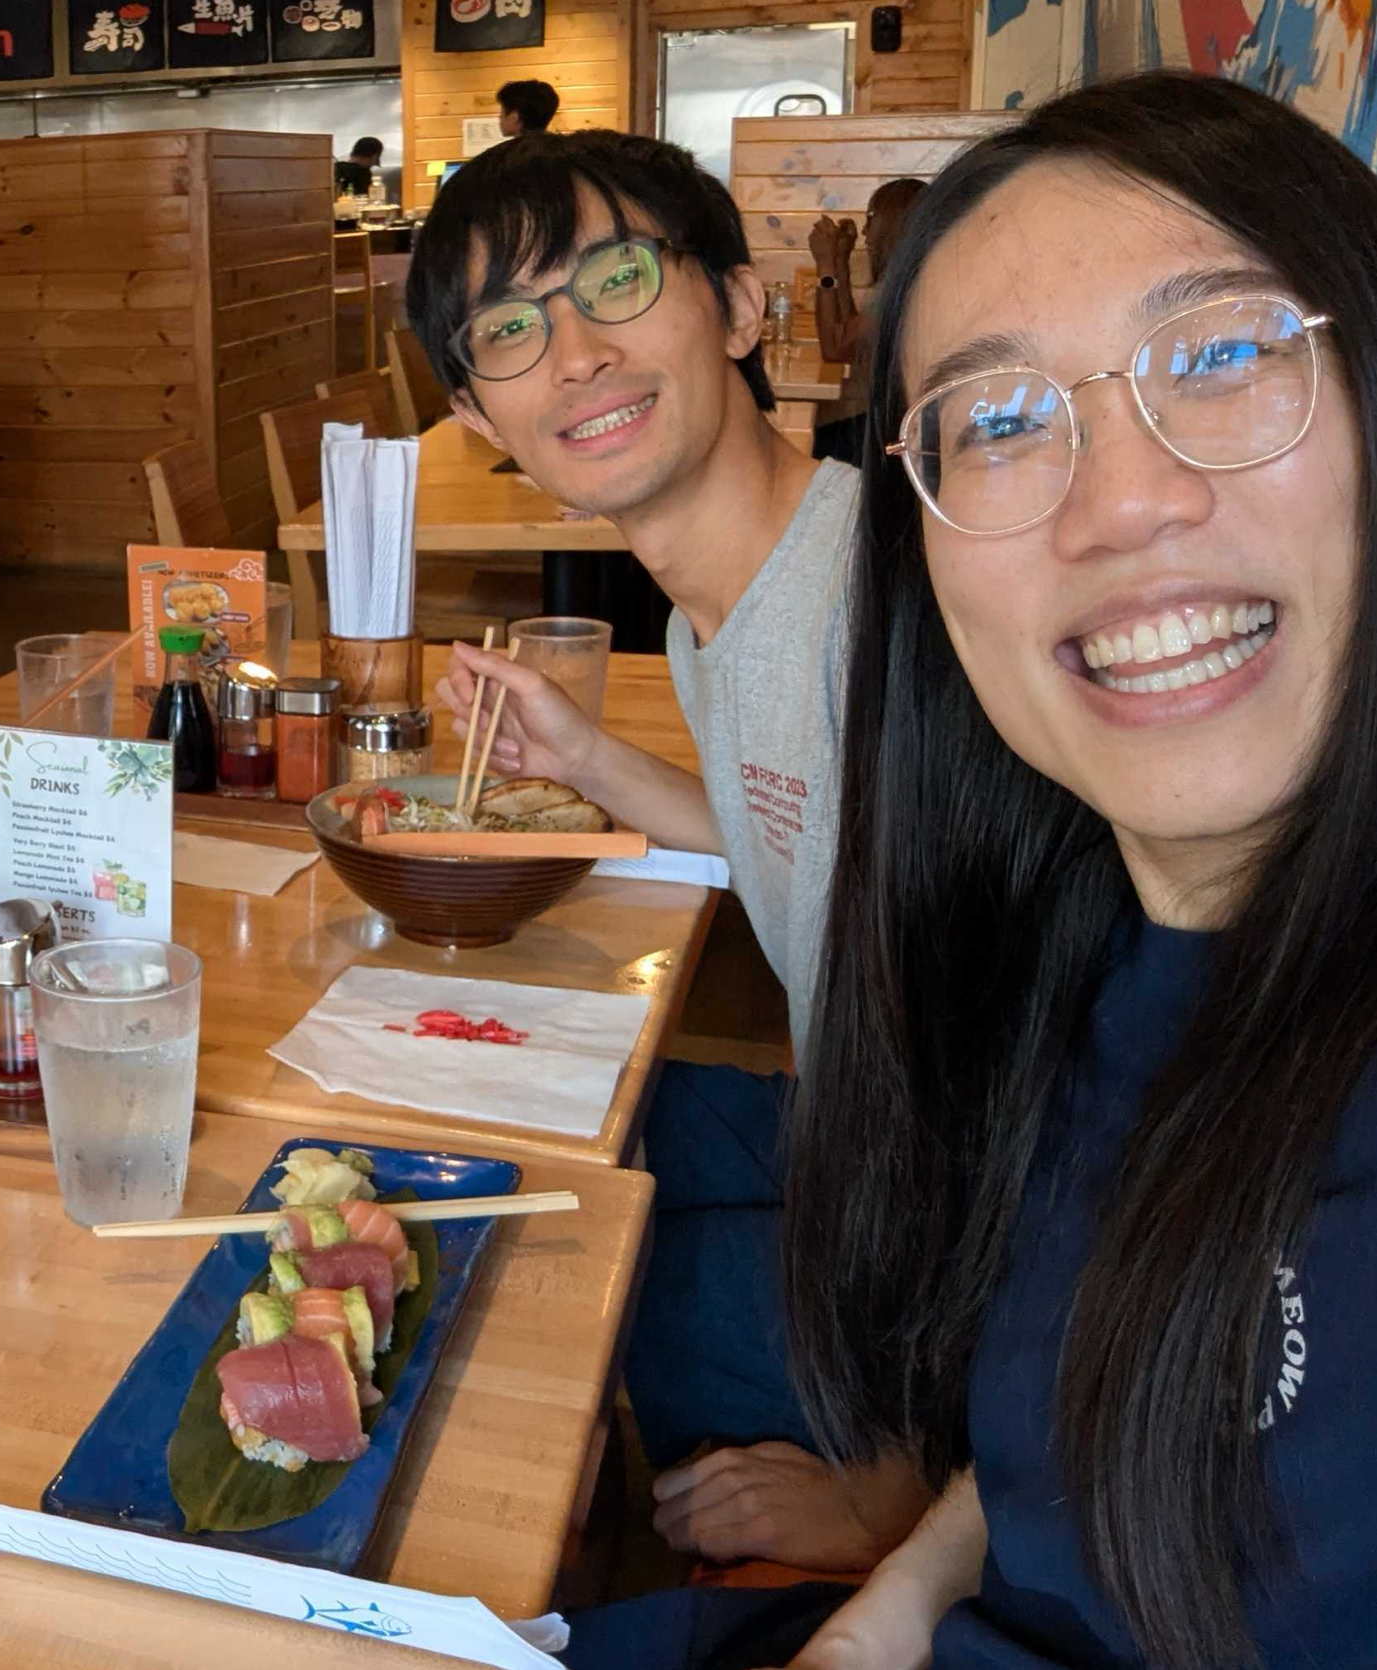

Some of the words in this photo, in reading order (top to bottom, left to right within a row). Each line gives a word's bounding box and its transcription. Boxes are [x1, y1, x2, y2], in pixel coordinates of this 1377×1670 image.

[83, 10, 146, 52] 寿司
[30, 777, 80, 796] DRINKS
[48, 806, 76, 815] Mocktail
[12, 812, 31, 820] Peach
[33, 815, 61, 824] Mocktail
[76, 831, 104, 842] Mocktail
[34, 862, 65, 872] Lemonade
[36, 873, 67, 883] Lemonade
